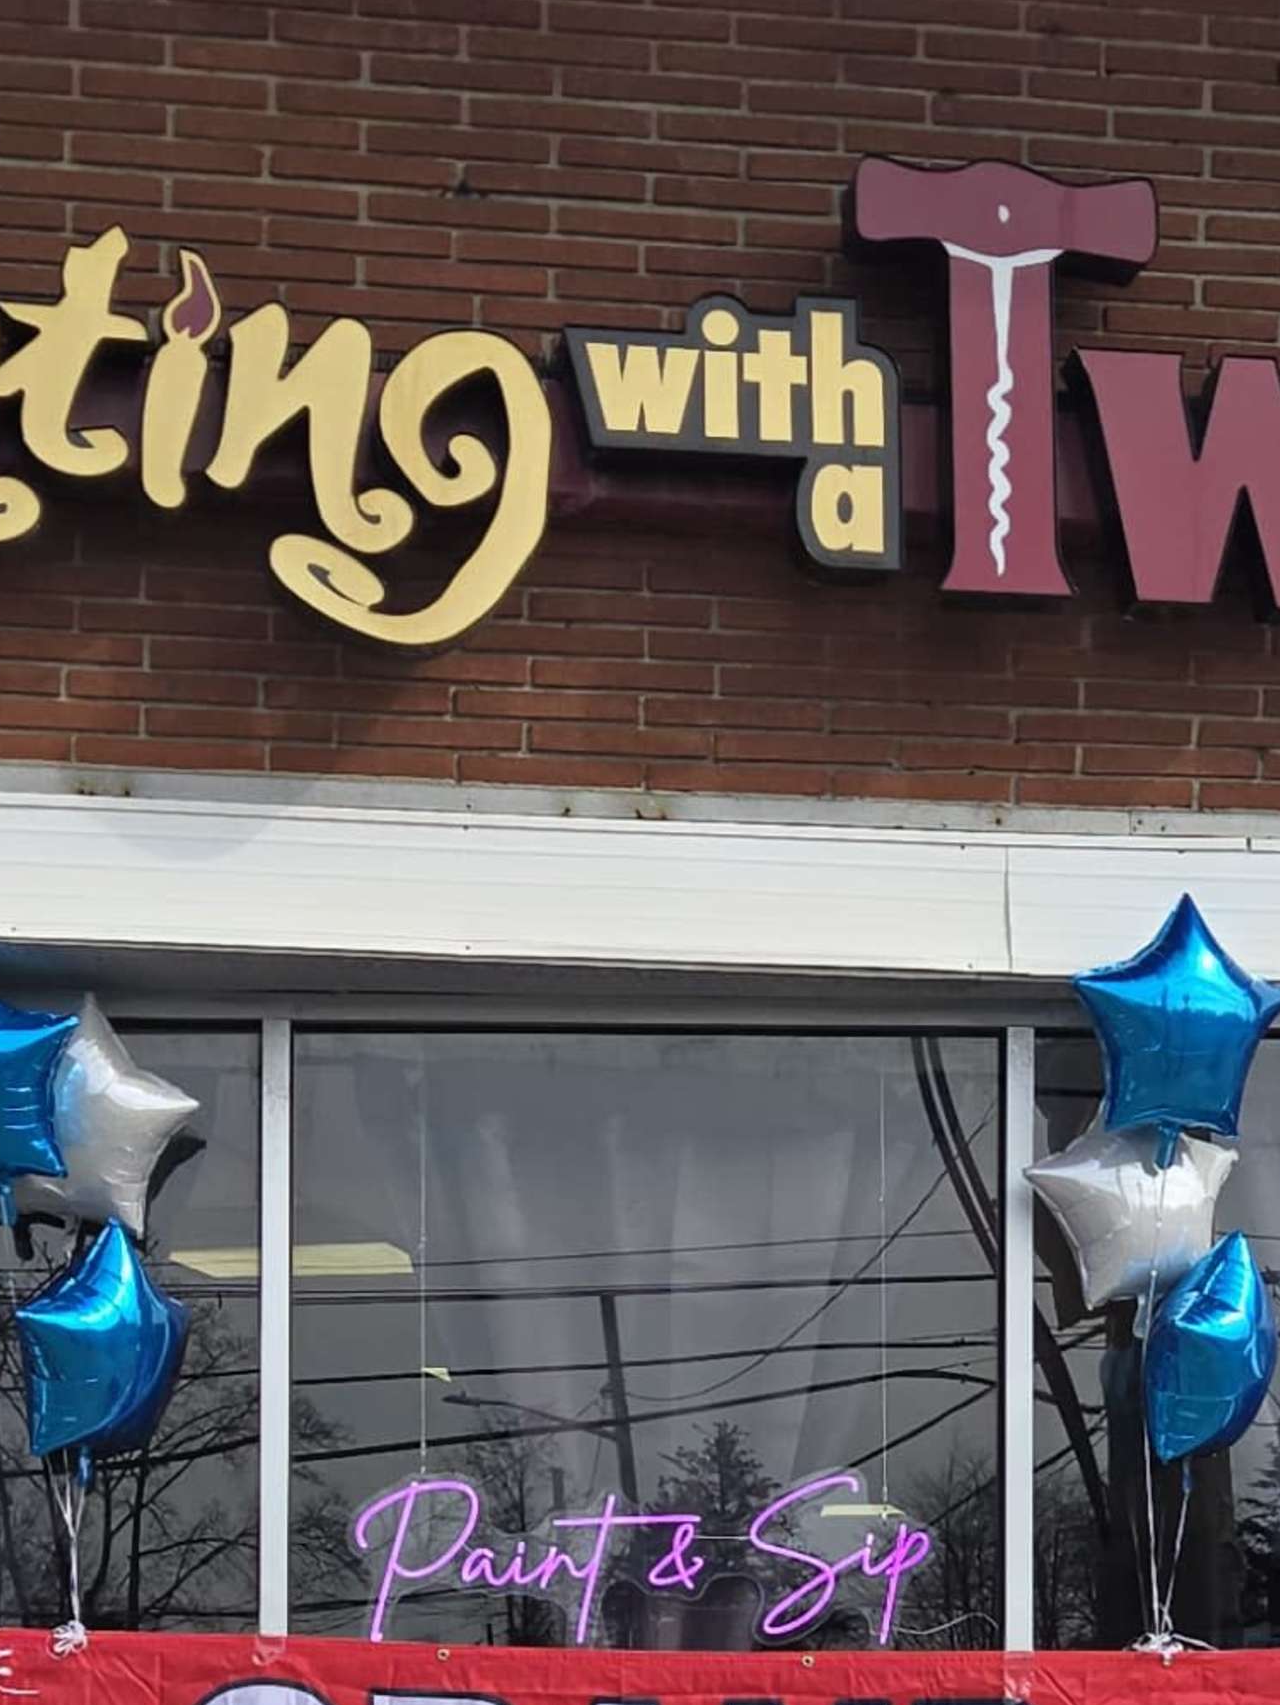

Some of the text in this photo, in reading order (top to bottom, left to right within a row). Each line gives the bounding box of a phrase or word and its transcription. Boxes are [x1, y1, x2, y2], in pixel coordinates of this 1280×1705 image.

[587, 306, 883, 446] with
[810, 463, 884, 554] a
[355, 1474, 931, 1645] Paint & Sip
